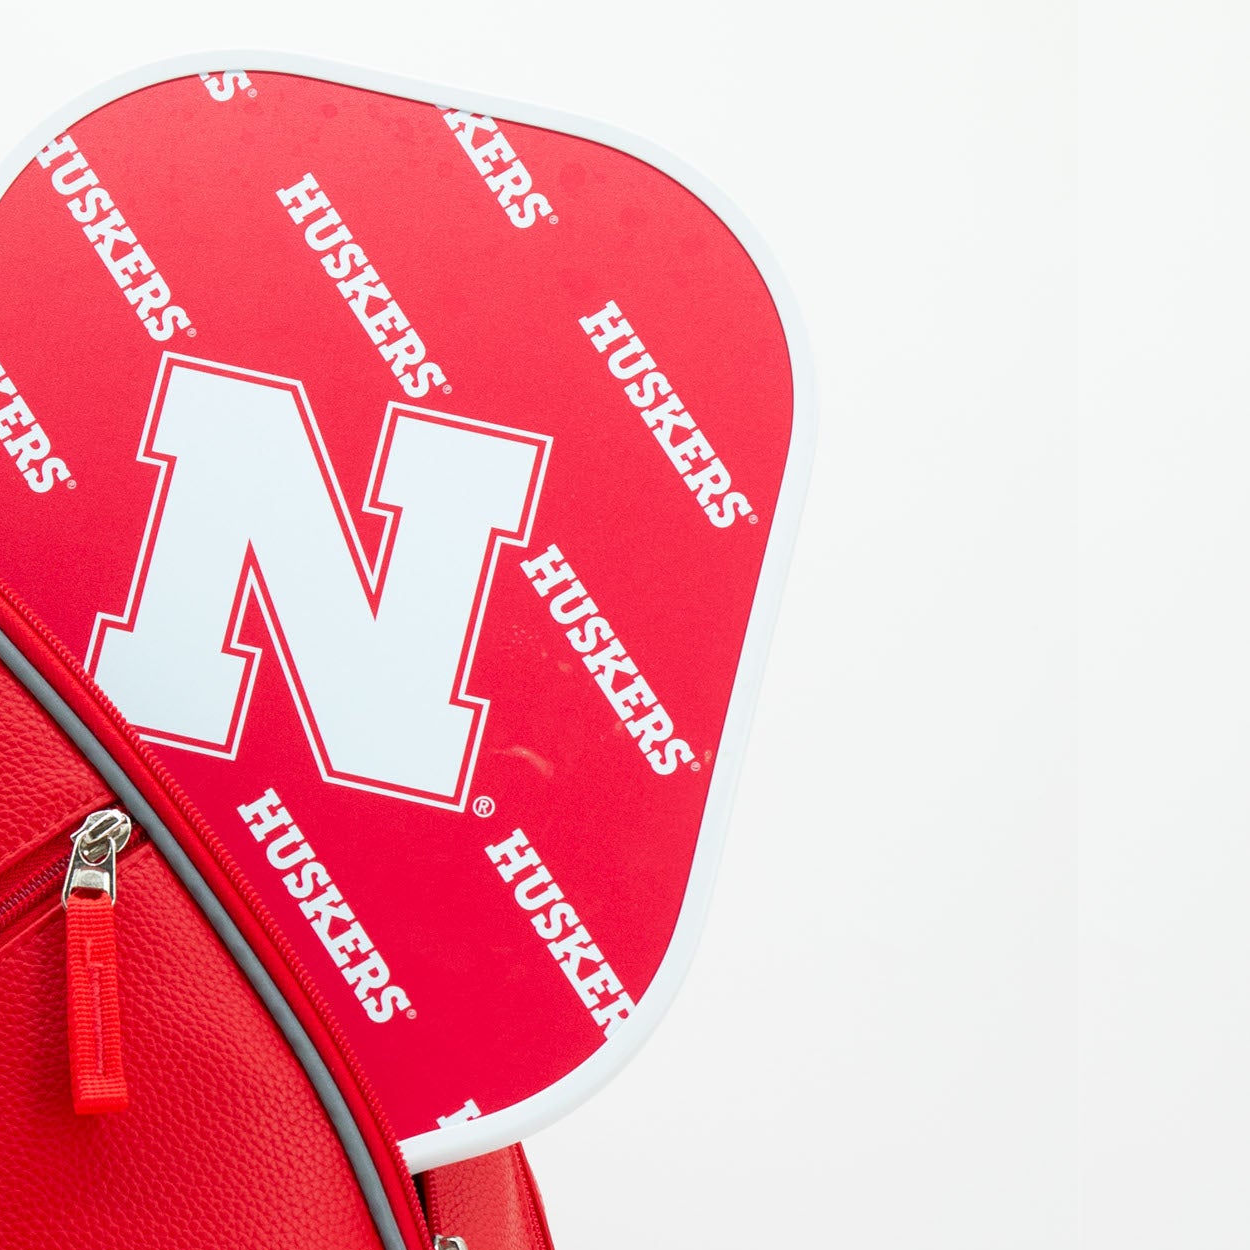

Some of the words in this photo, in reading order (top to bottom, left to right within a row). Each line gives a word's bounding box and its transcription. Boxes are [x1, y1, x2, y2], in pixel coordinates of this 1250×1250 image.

[36, 135, 191, 342] HUSKERS
[435, 104, 553, 229] KERS
[276, 172, 447, 399] HUSKERS
[578, 299, 752, 529] HUSKERS
[84, 351, 554, 813] N
[519, 543, 695, 776] HUSKERS
[236, 787, 411, 1024] HUSKERS
